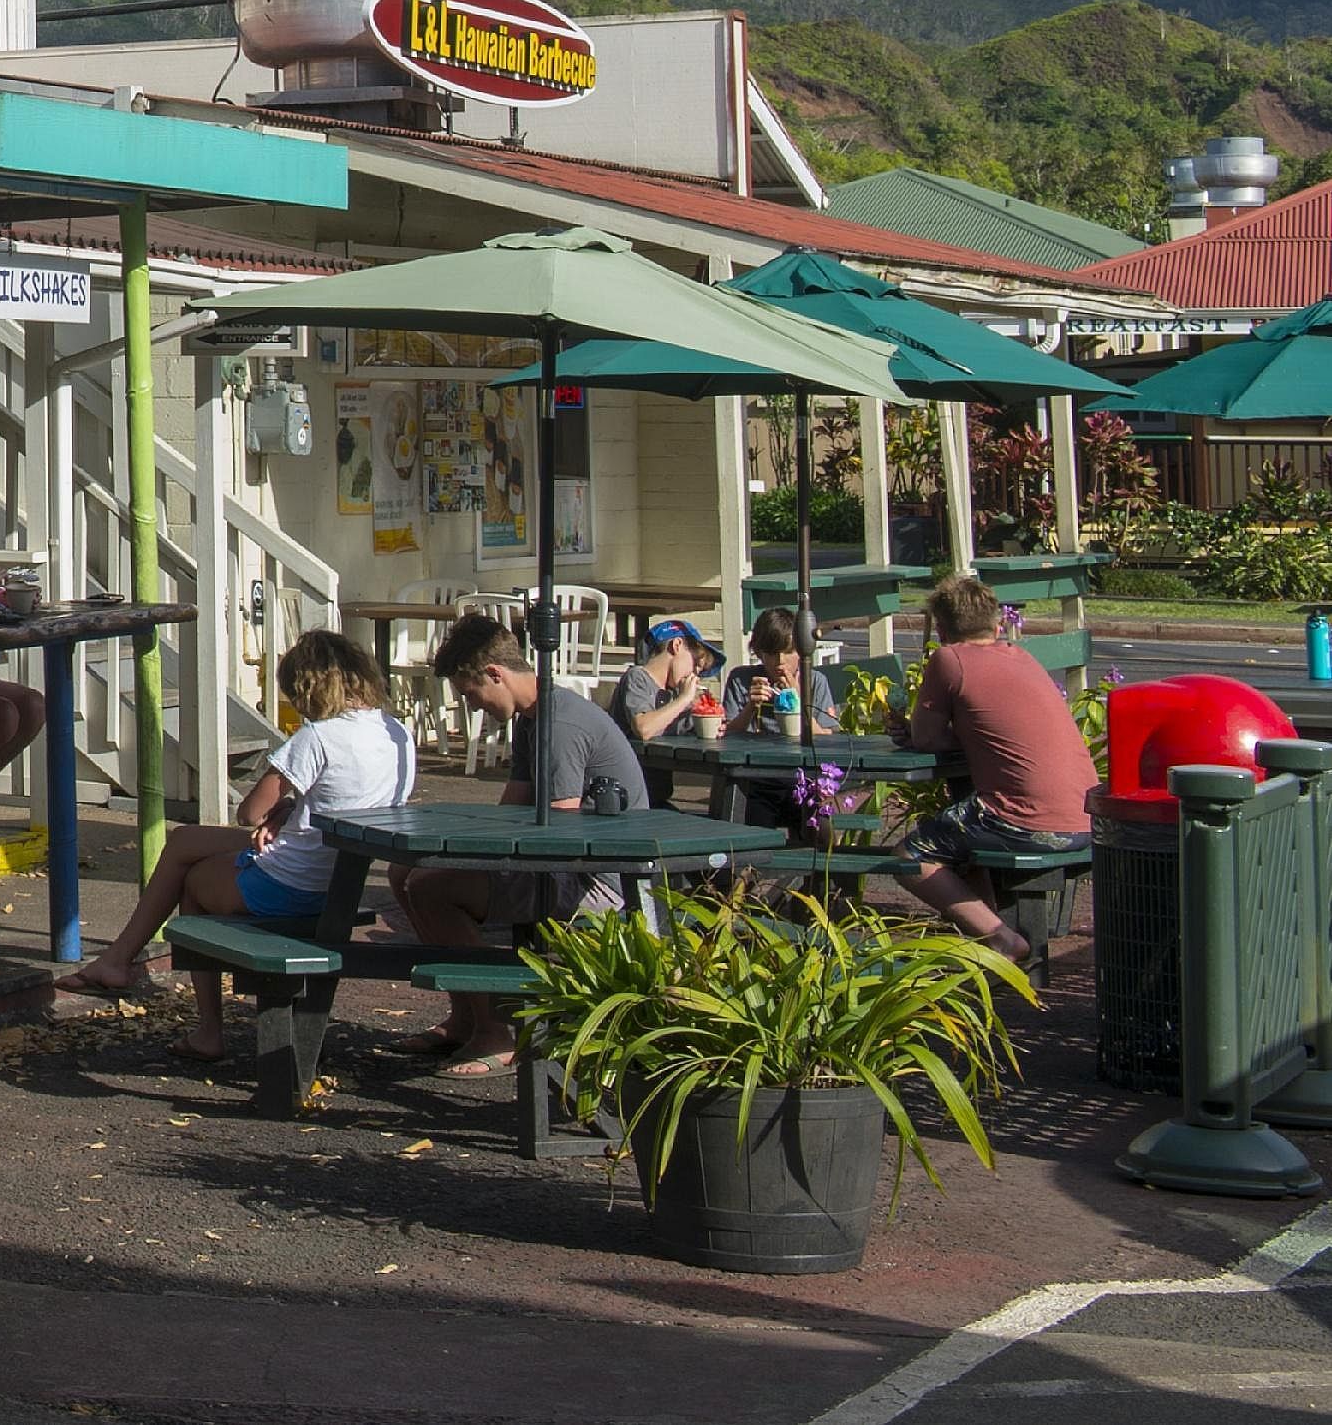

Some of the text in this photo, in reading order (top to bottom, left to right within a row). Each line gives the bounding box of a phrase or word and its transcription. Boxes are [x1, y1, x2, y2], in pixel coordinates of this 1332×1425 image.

[455, 13, 526, 74] Hawaiian
[529, 31, 597, 91] Barbecue
[1067, 318, 1228, 333] REAKFAST
[221, 334, 280, 343] ENTRANCE
